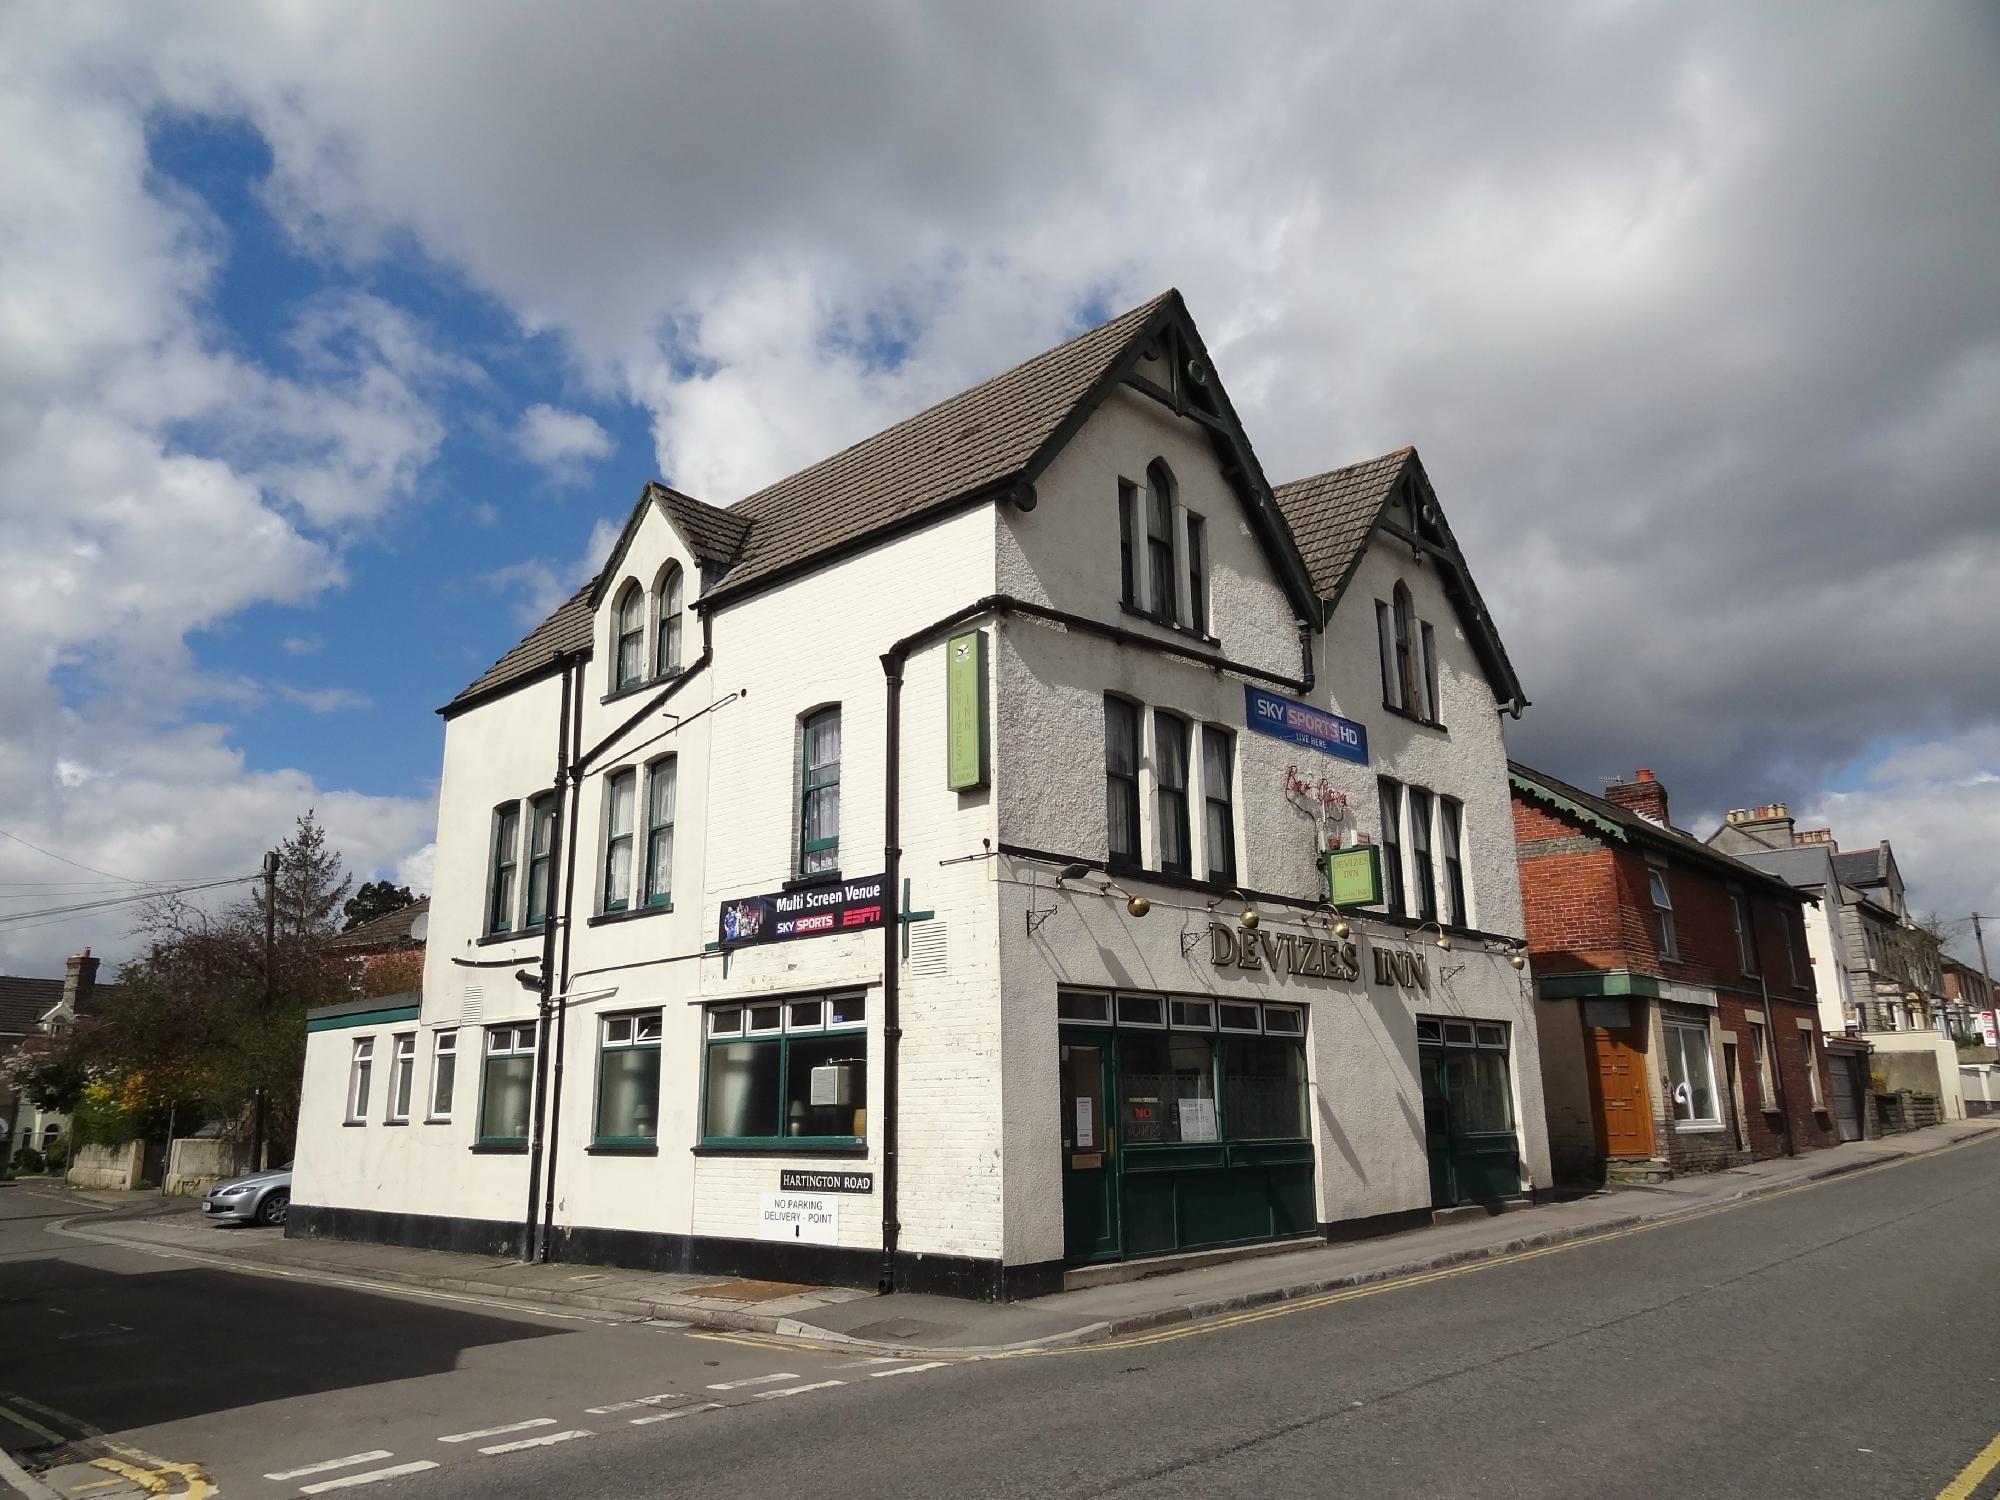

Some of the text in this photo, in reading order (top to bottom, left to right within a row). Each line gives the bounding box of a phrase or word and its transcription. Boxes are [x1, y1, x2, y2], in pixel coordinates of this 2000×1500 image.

[1257, 699, 1358, 745] SKY SPORTS HD
[1296, 732, 1327, 749] LIVE HERE
[776, 884, 881, 912] Multi Screen Venue
[776, 905, 881, 934] SKY SPORTS ESPN
[1208, 921, 1431, 992] DEVIZES INN
[1134, 1106, 1153, 1120] NO
[783, 1174, 871, 1189] HARTINGTON ROAD
[774, 1199, 823, 1210] NO PARKING
[764, 1210, 801, 1221] DELIVERY
[808, 1213, 833, 1224] POINT
